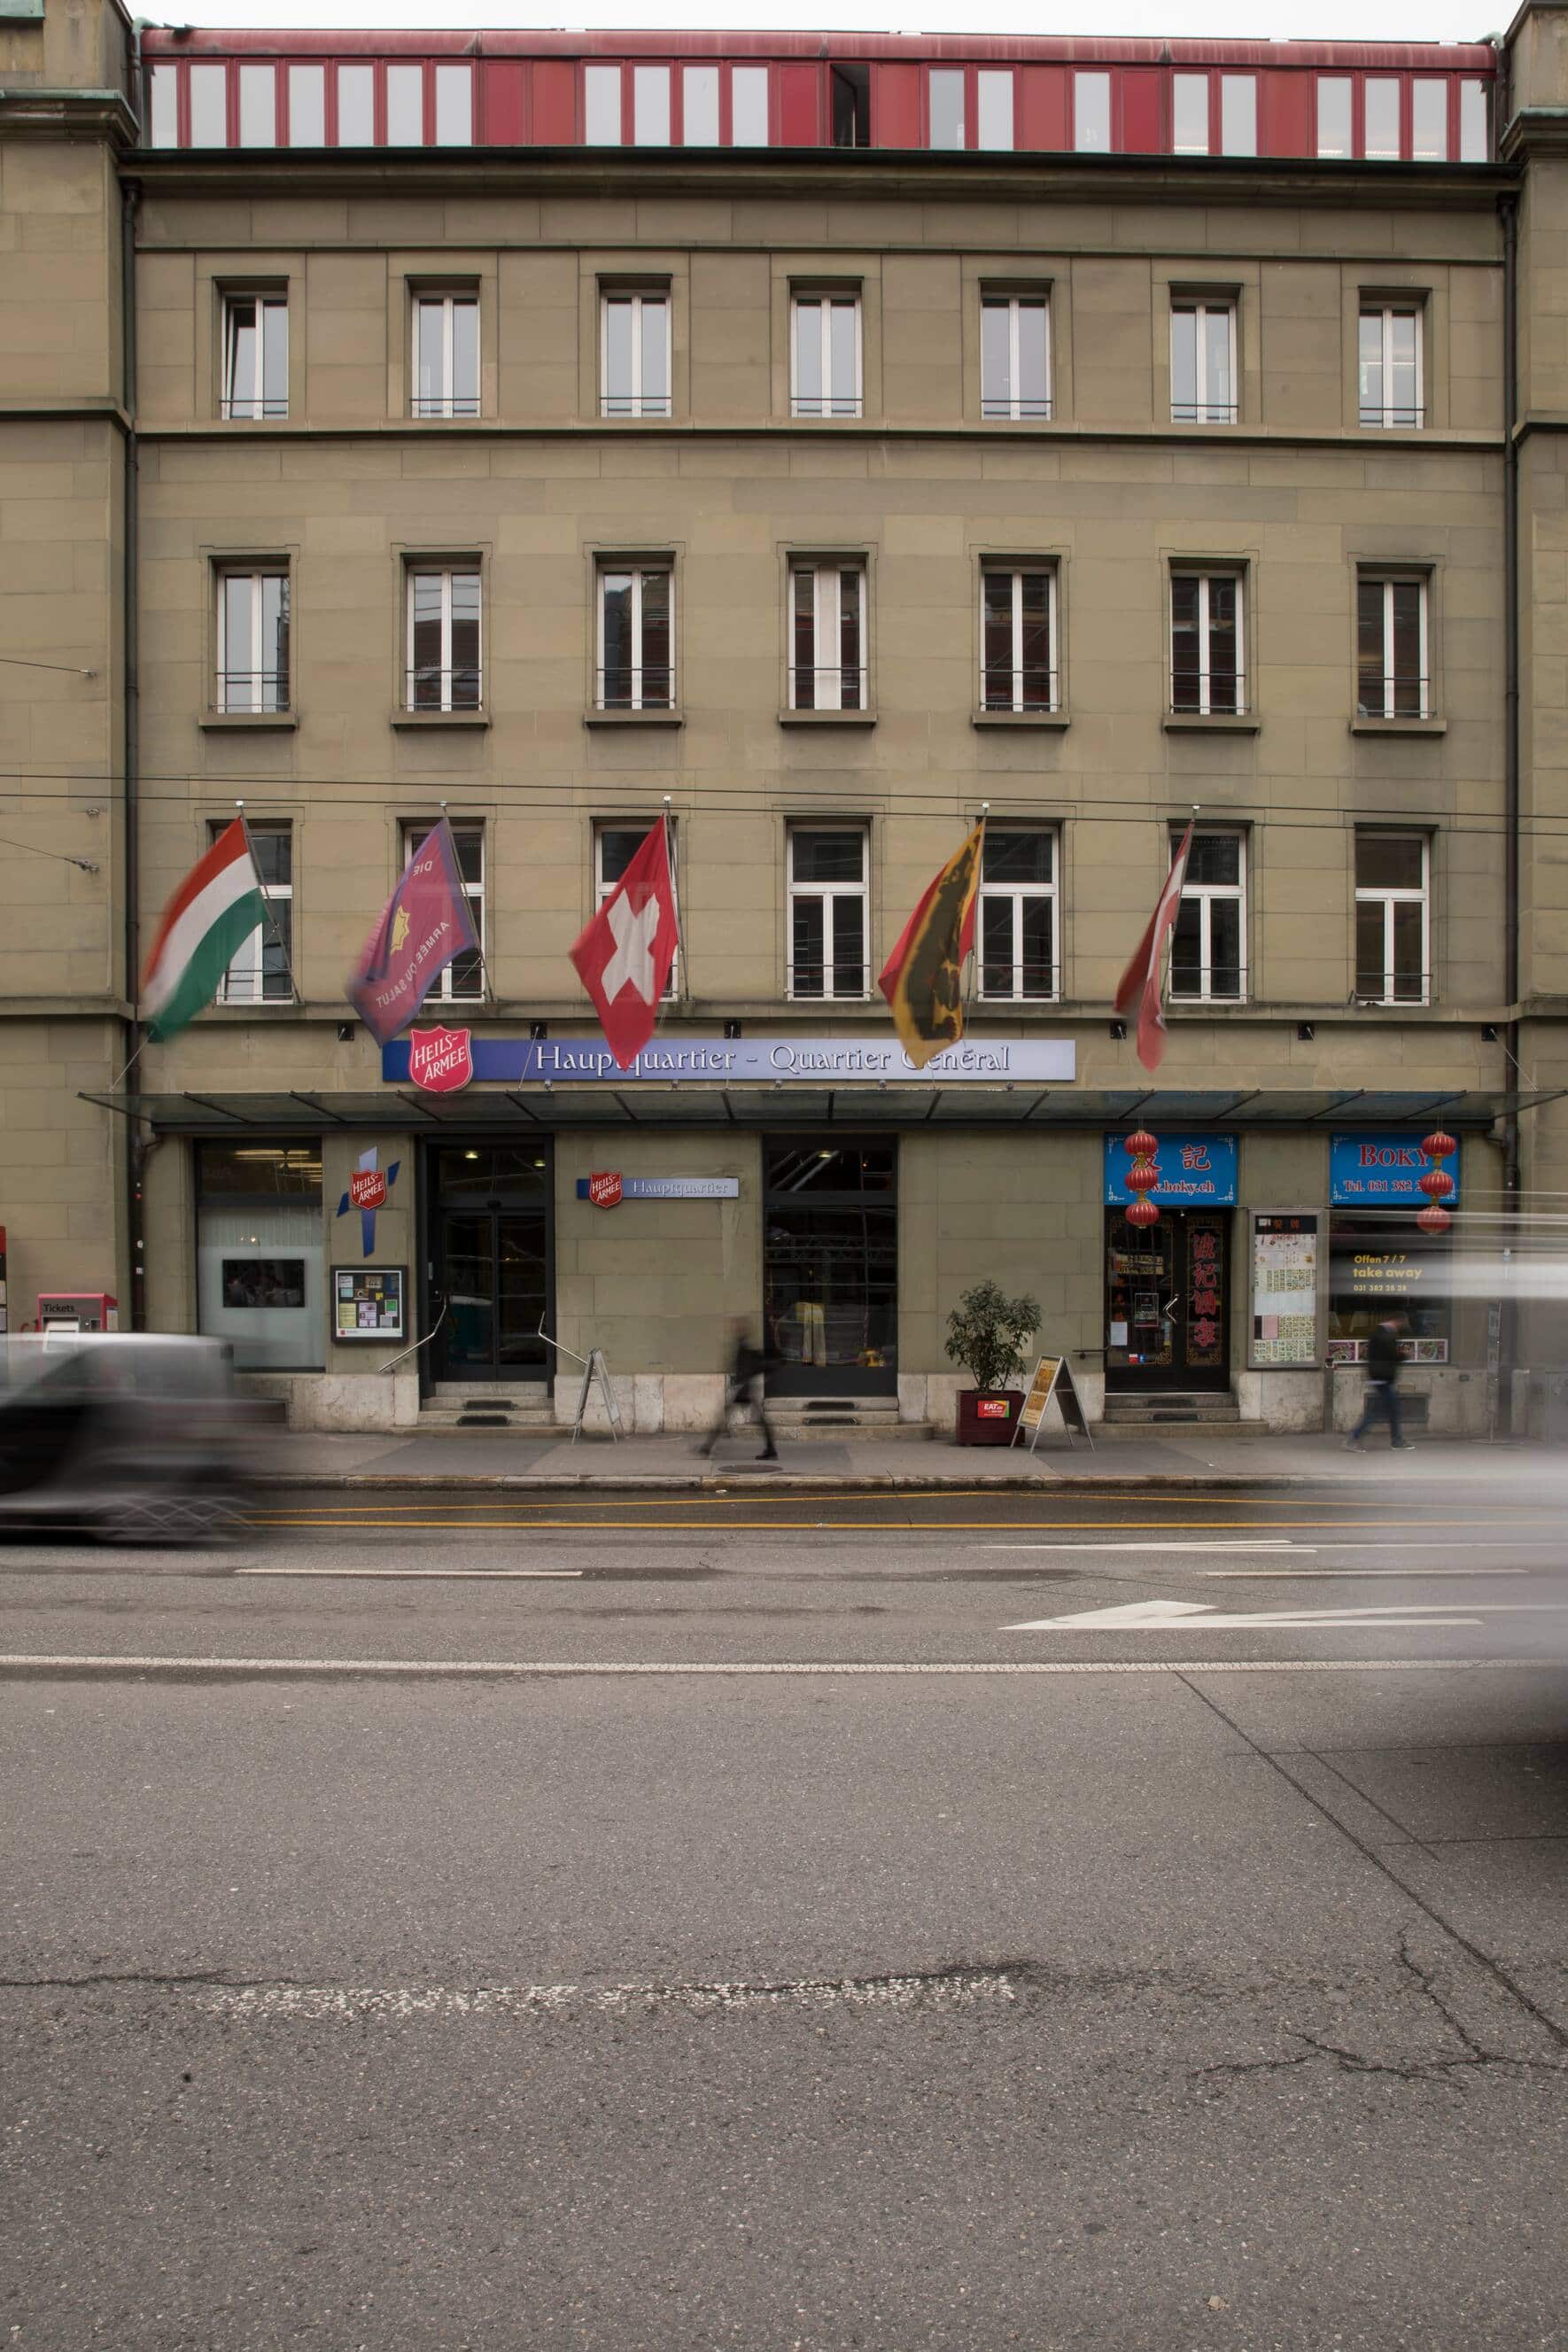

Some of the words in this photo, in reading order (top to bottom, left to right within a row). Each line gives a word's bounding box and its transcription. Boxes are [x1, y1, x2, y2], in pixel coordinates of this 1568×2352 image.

[415, 1035, 459, 1069] HEILS-
[770, 1045, 891, 1075] Quartier
[423, 1045, 467, 1083] ARMEE
[353, 1174, 378, 1195] HEILS-
[358, 1182, 384, 1204] ARMEE
[592, 1175, 617, 1194] HEILS-
[596, 1181, 621, 1202] ARMEE
[633, 1181, 729, 1197] Hauptquartier
[1344, 1179, 1364, 1192] Tel.
[1368, 1180, 1388, 1192] 031
[1391, 1180, 1412, 1192] 382
[1354, 1255, 1381, 1264] Offen
[1354, 1267, 1382, 1277] take
[1386, 1269, 1423, 1279] away
